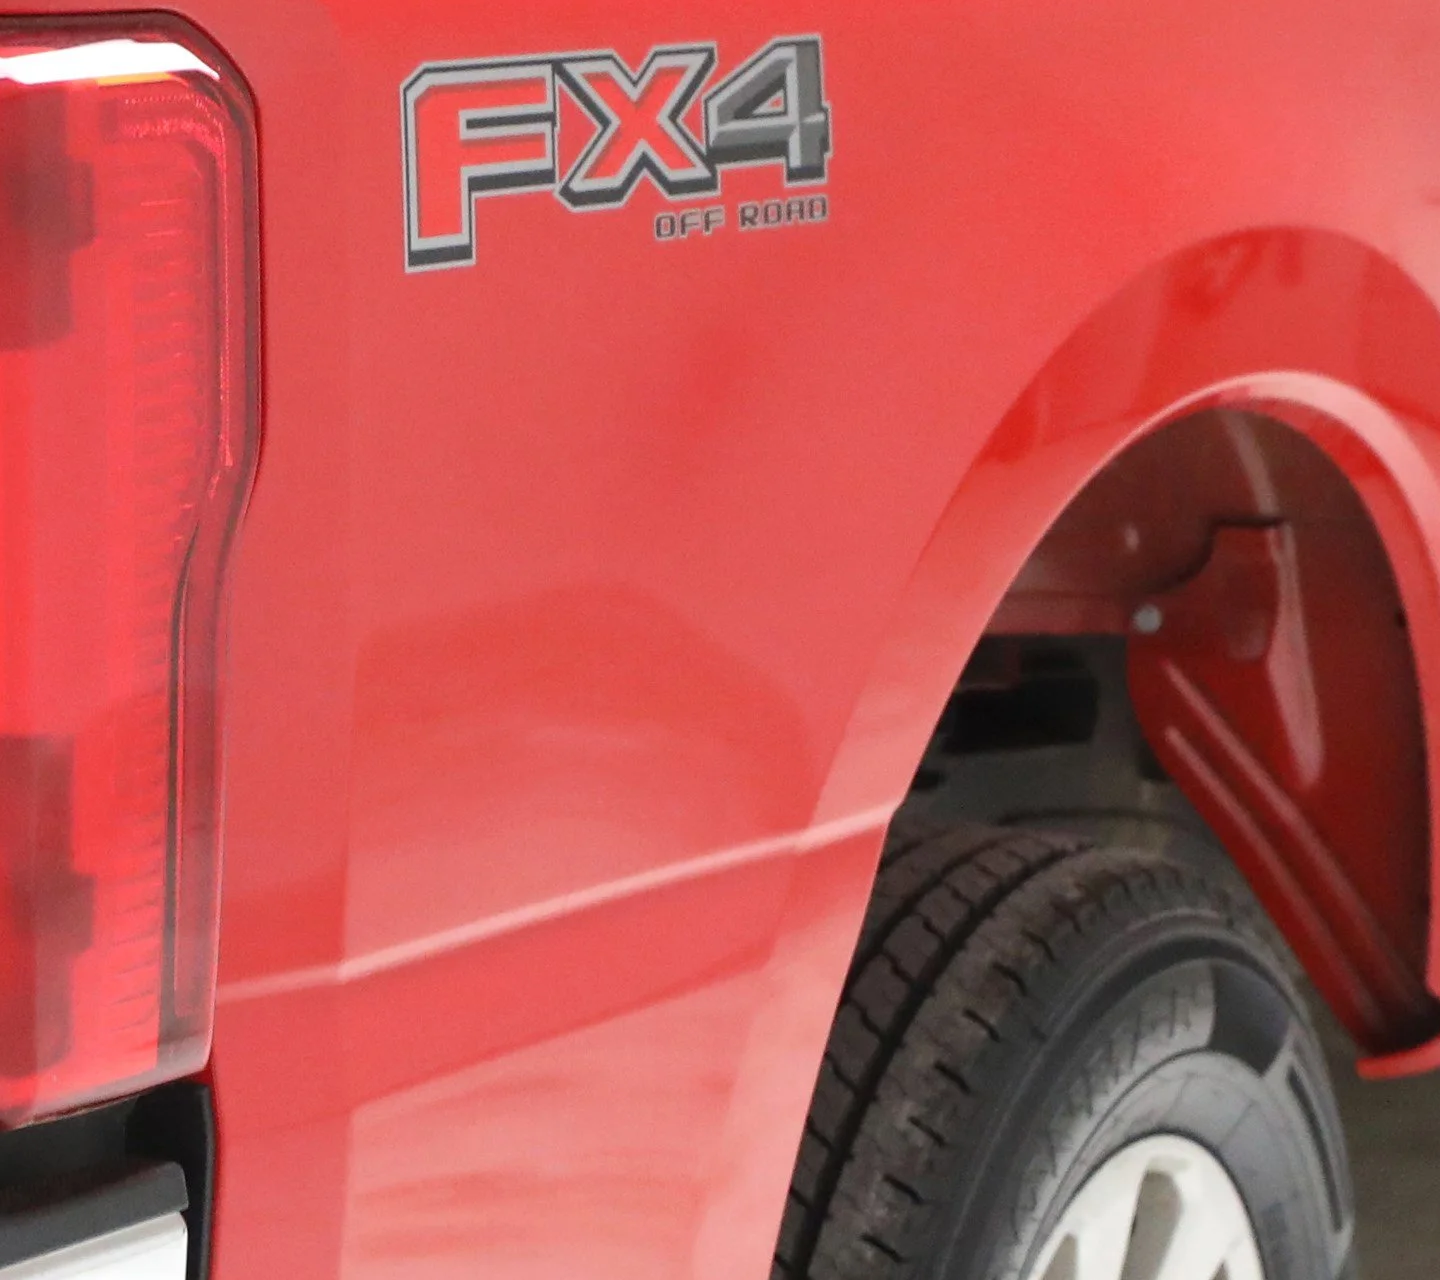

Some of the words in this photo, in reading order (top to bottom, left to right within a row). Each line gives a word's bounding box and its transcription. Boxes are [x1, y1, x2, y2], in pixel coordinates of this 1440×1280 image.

[400, 33, 832, 274] FX4
[653, 207, 725, 241] OFF
[738, 195, 829, 232] ROAD
